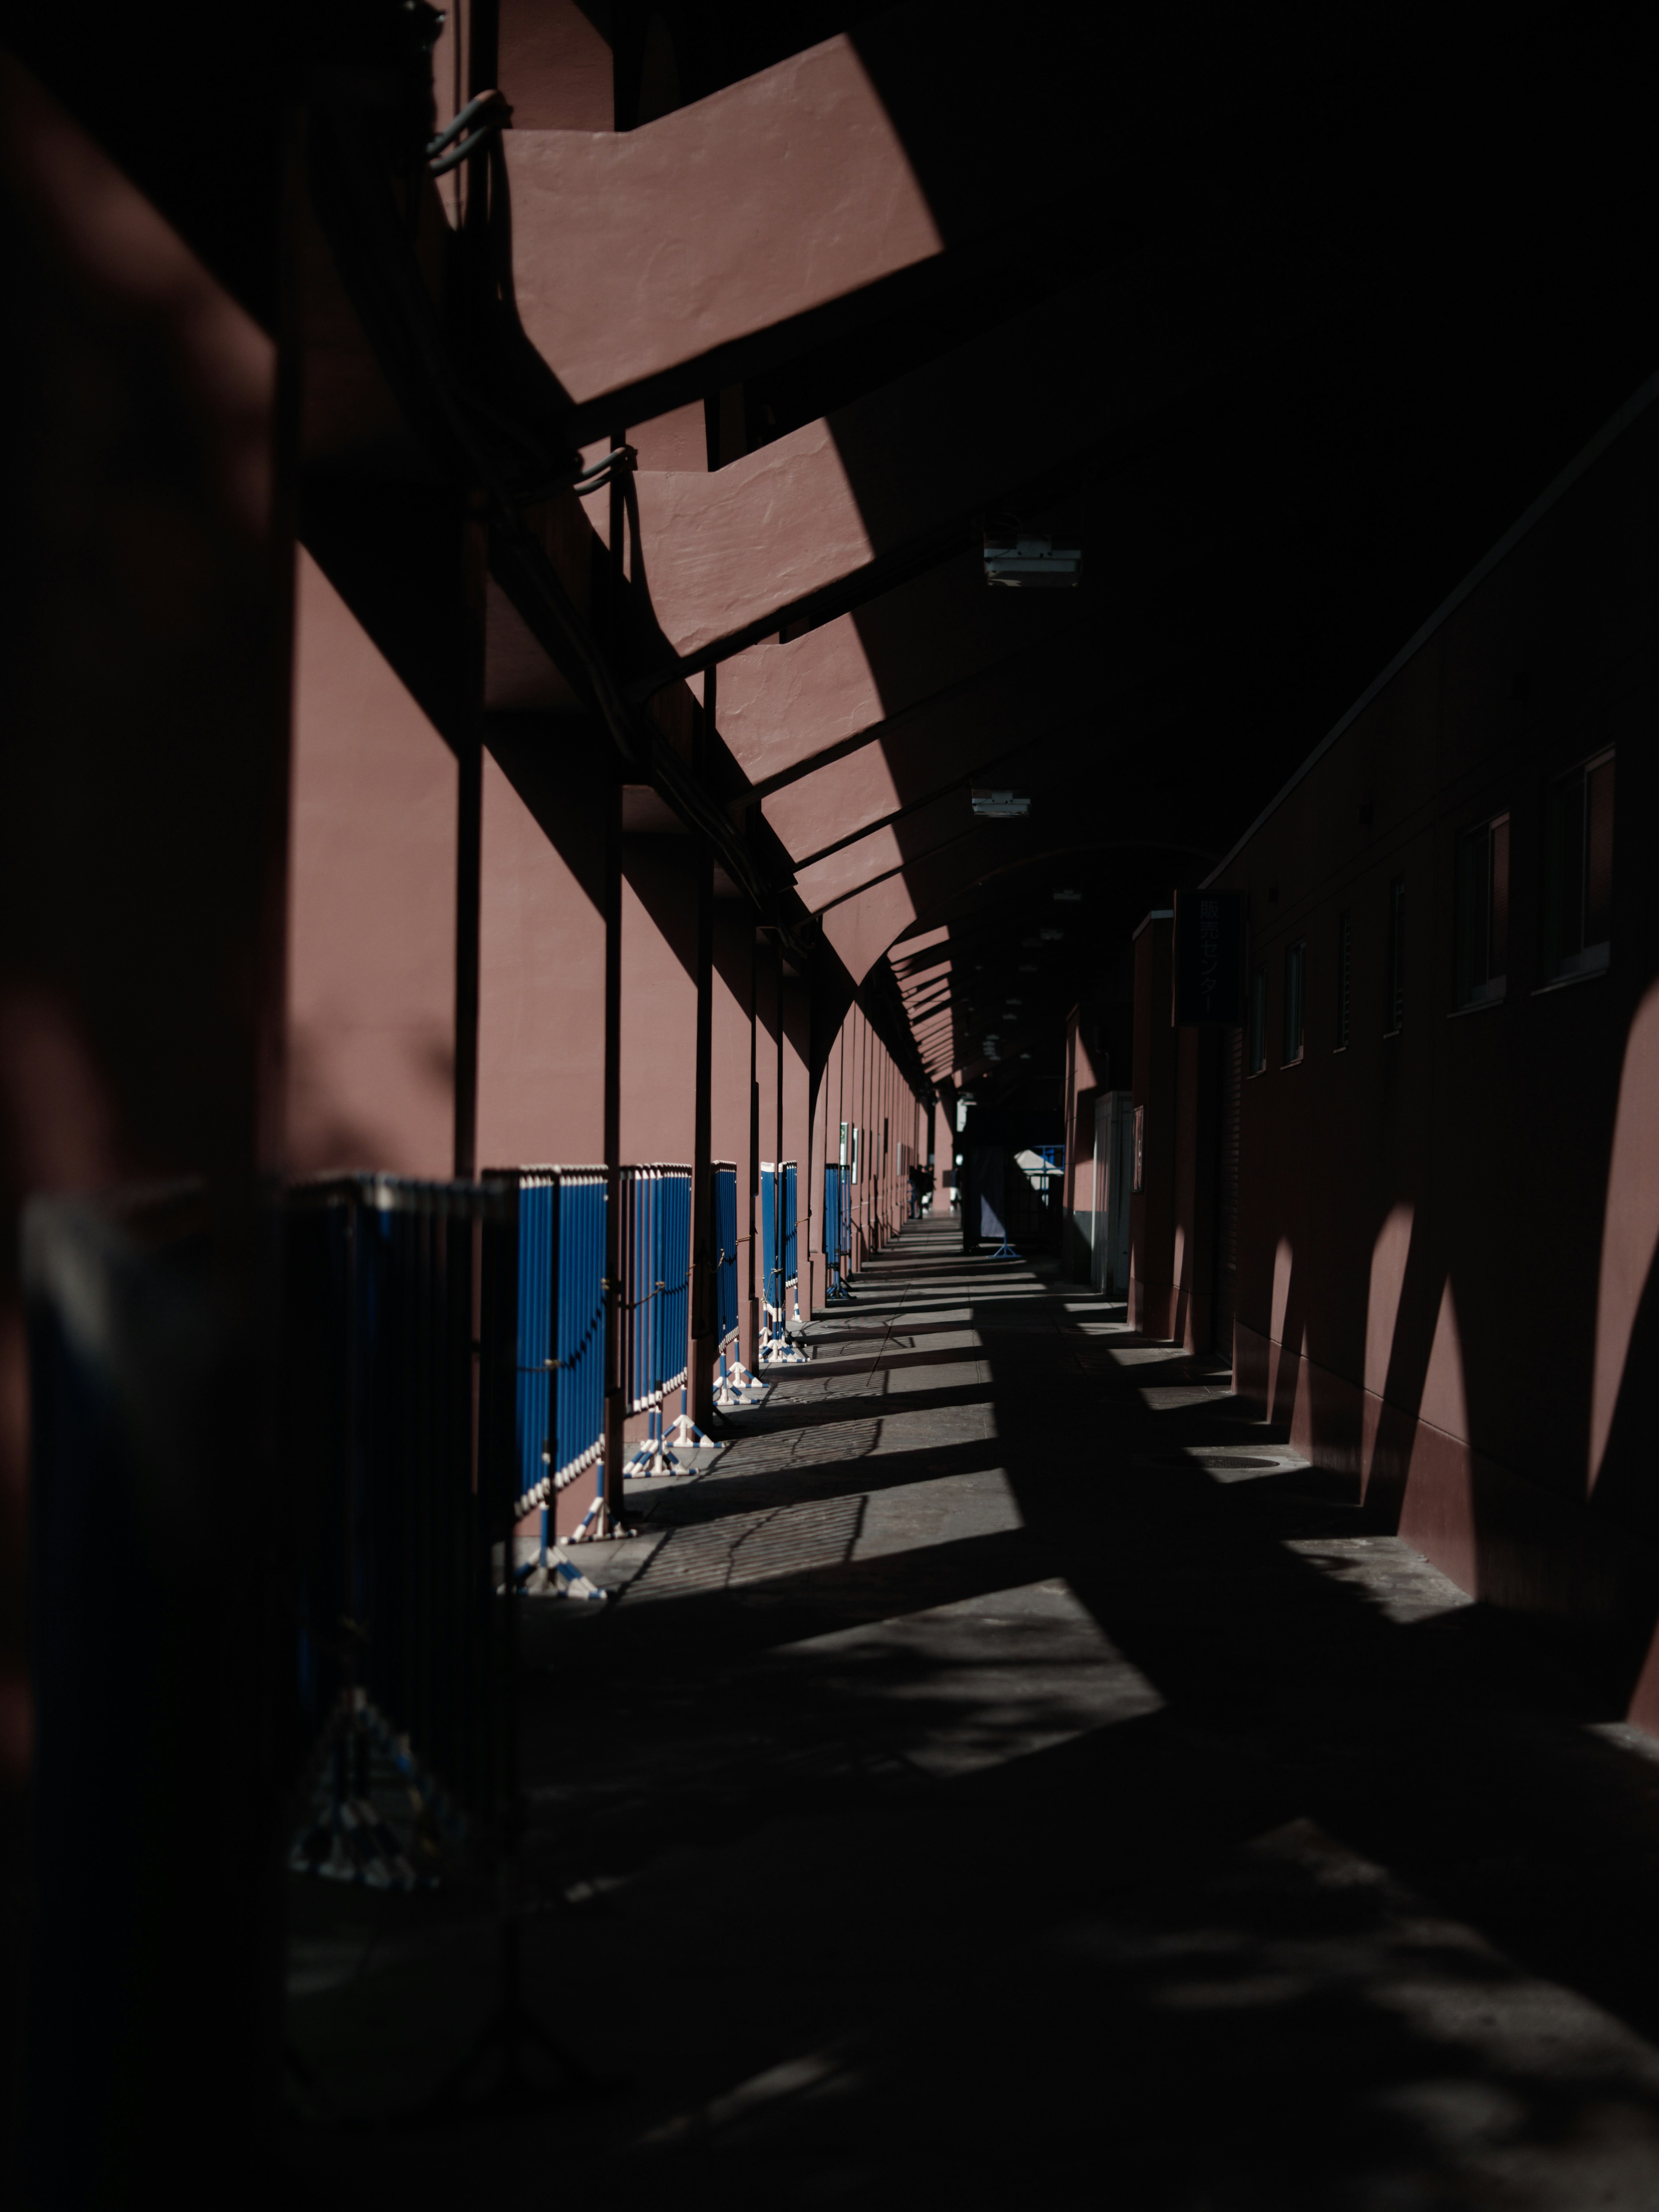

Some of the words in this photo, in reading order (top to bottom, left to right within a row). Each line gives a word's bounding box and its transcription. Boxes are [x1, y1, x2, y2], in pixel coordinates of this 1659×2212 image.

[1200, 900, 1219, 1013] 販売センター
